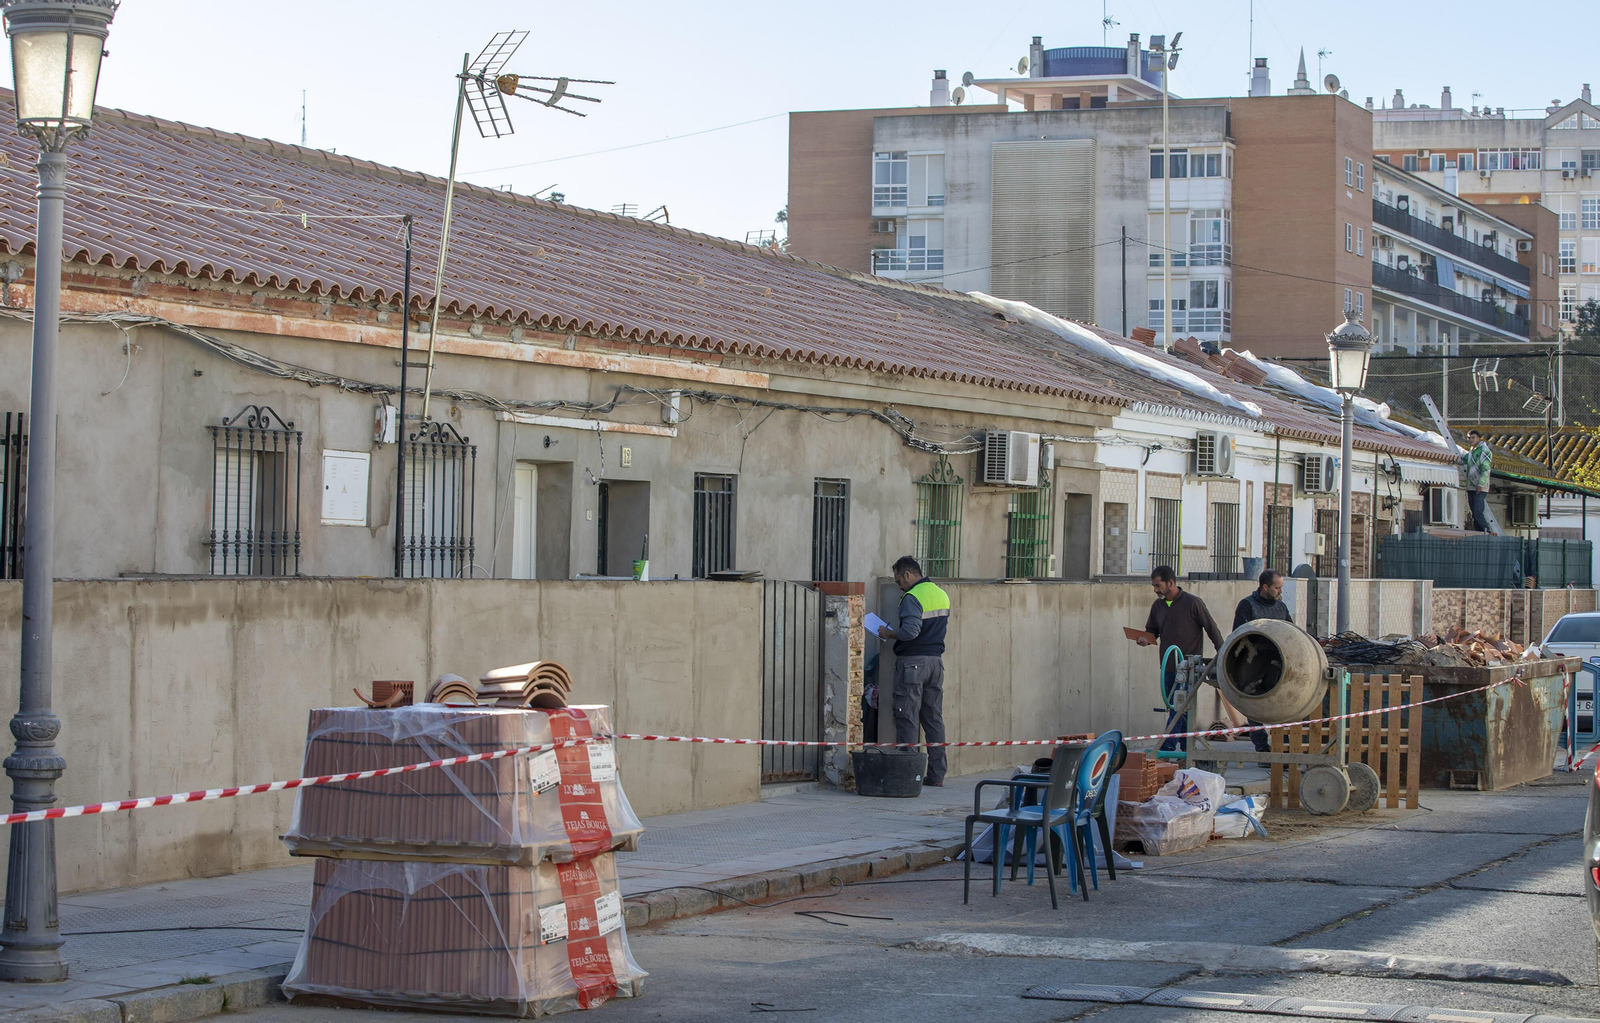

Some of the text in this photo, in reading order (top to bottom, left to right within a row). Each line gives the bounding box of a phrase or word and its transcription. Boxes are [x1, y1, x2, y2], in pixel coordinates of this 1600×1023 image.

[565, 820, 608, 831] TEJAS BORJA
[560, 869, 595, 882] TEJAS BORJA
[571, 955, 589, 967] TEJAS
[589, 954, 608, 963] BORJA
